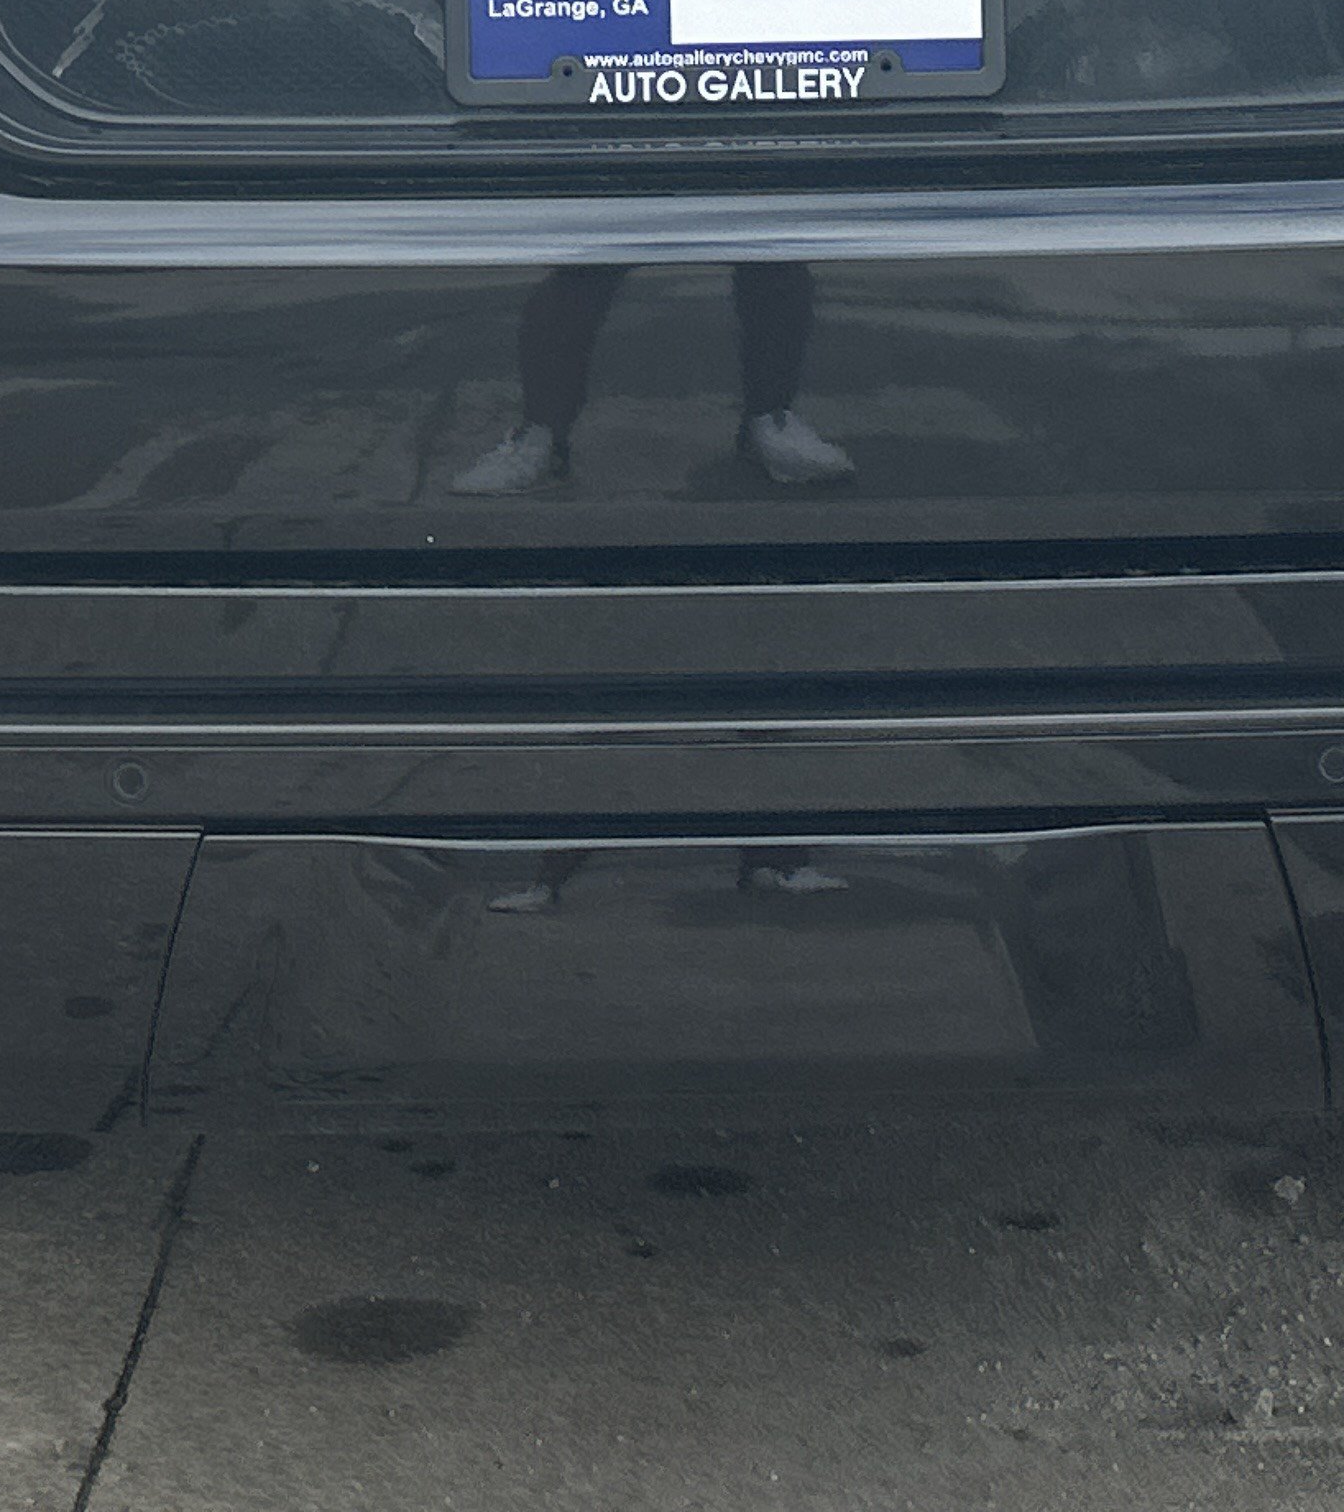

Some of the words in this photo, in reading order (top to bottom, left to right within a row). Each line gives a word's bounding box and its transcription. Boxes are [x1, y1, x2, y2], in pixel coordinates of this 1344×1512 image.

[584, 49, 869, 68] www.autogallerychevygmc.com
[589, 70, 687, 103] AUTO
[697, 67, 865, 101] GALLERY
